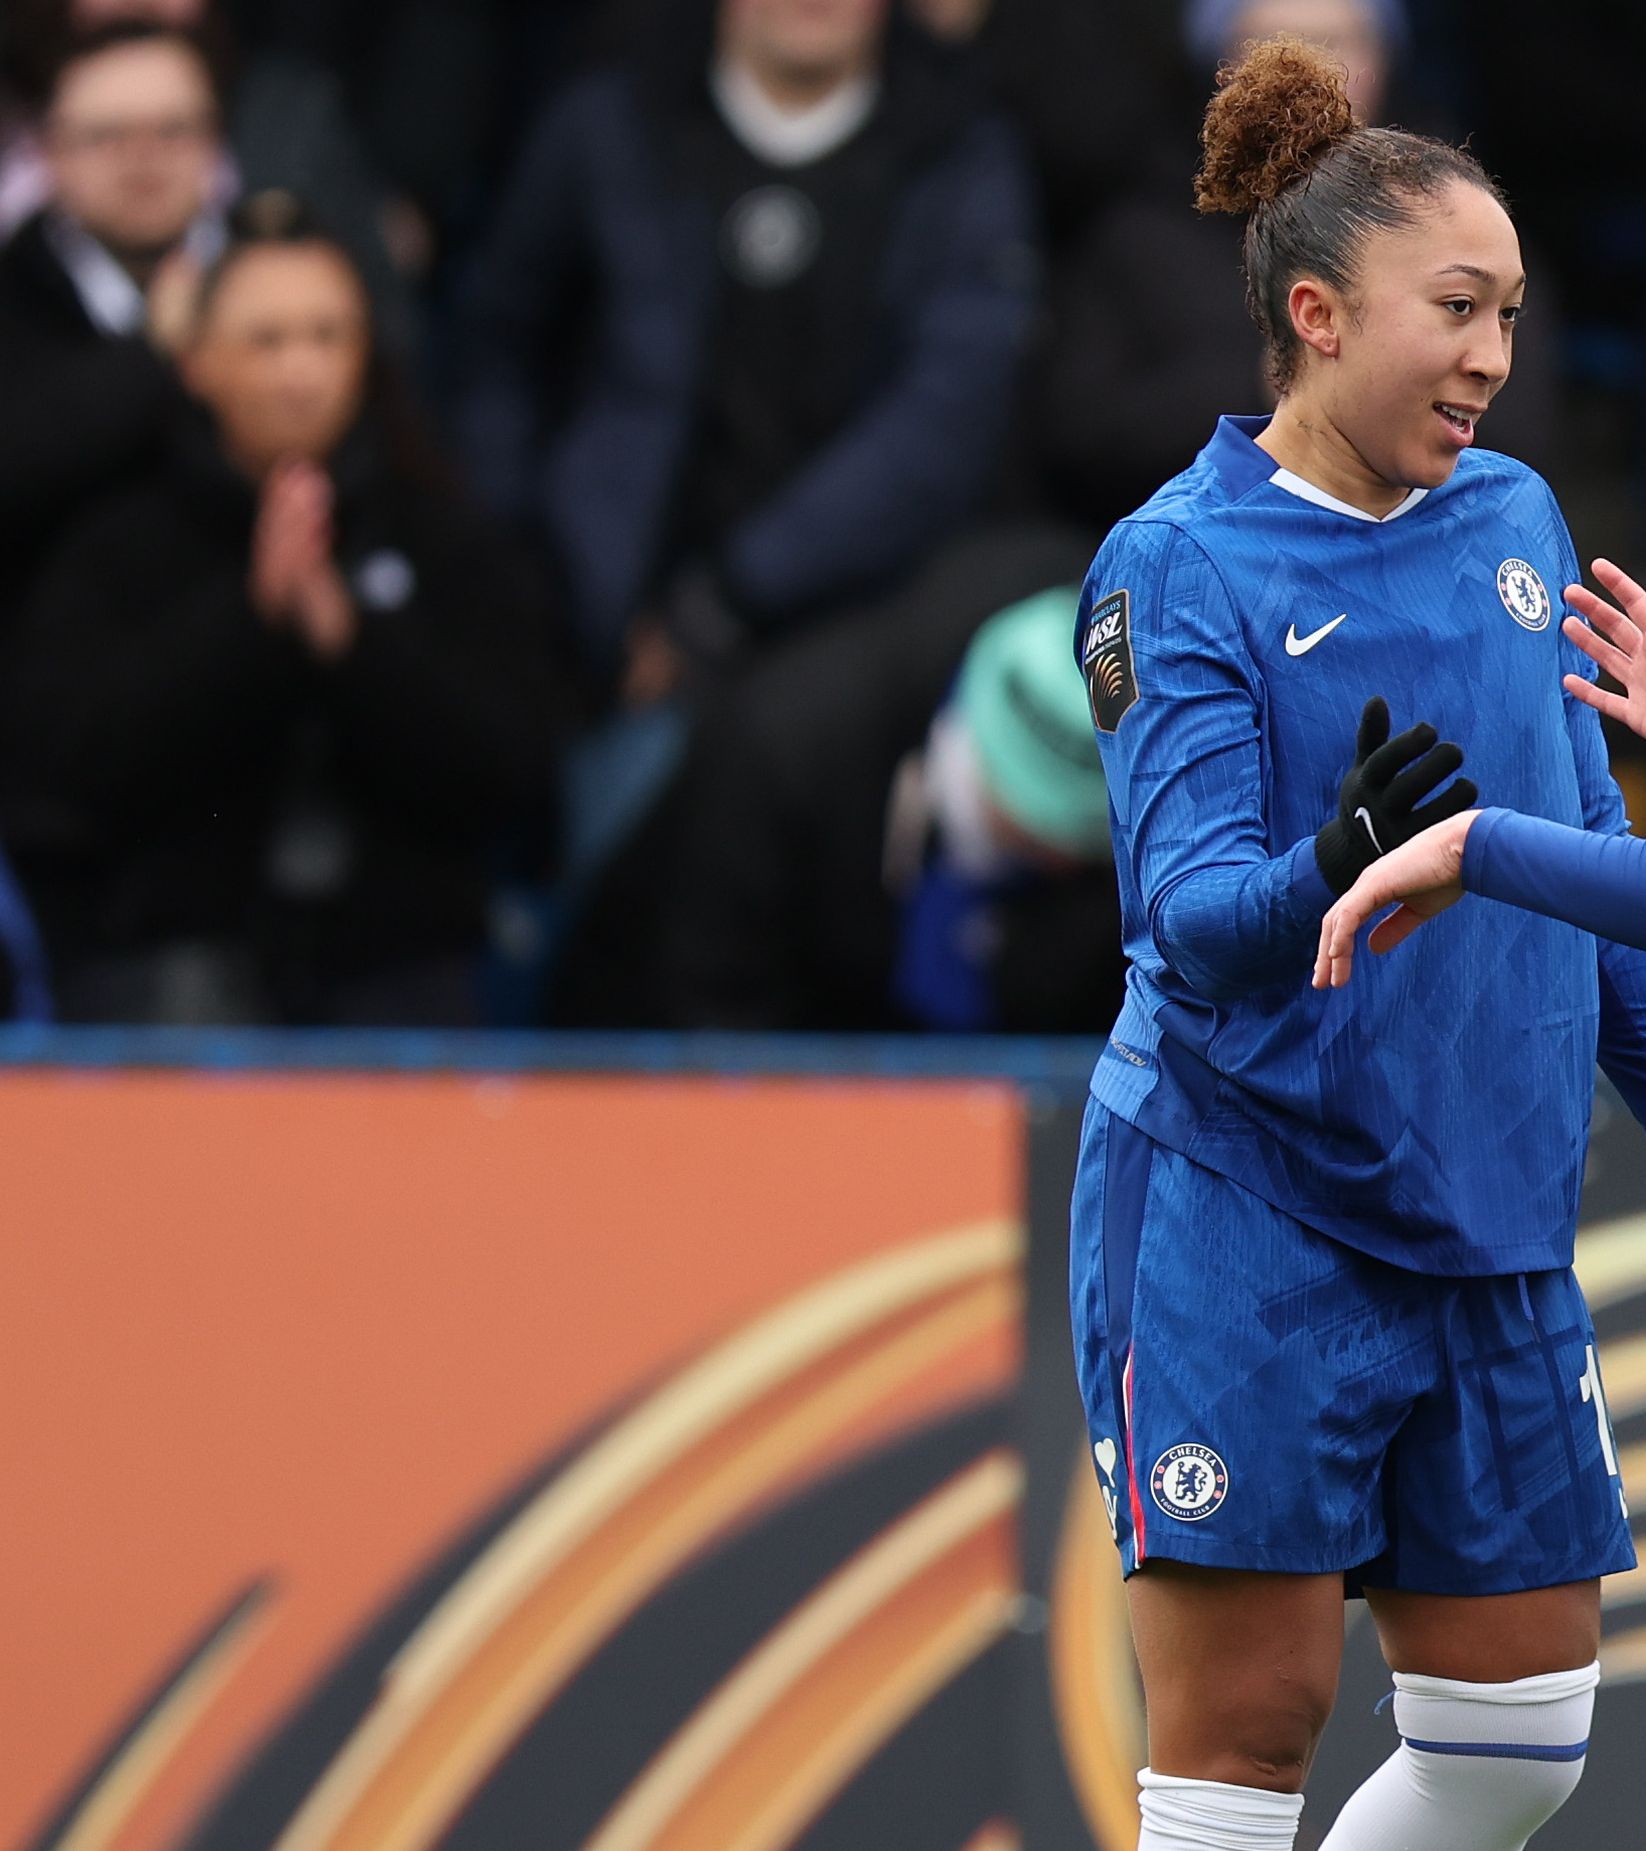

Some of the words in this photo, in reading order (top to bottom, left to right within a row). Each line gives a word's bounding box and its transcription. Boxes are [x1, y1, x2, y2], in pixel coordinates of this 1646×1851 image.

[1168, 1446, 1217, 1467] CHELSEA
[1160, 1498, 1191, 1517] FOOTBALL
[1193, 1504, 1210, 1516] CLUB
